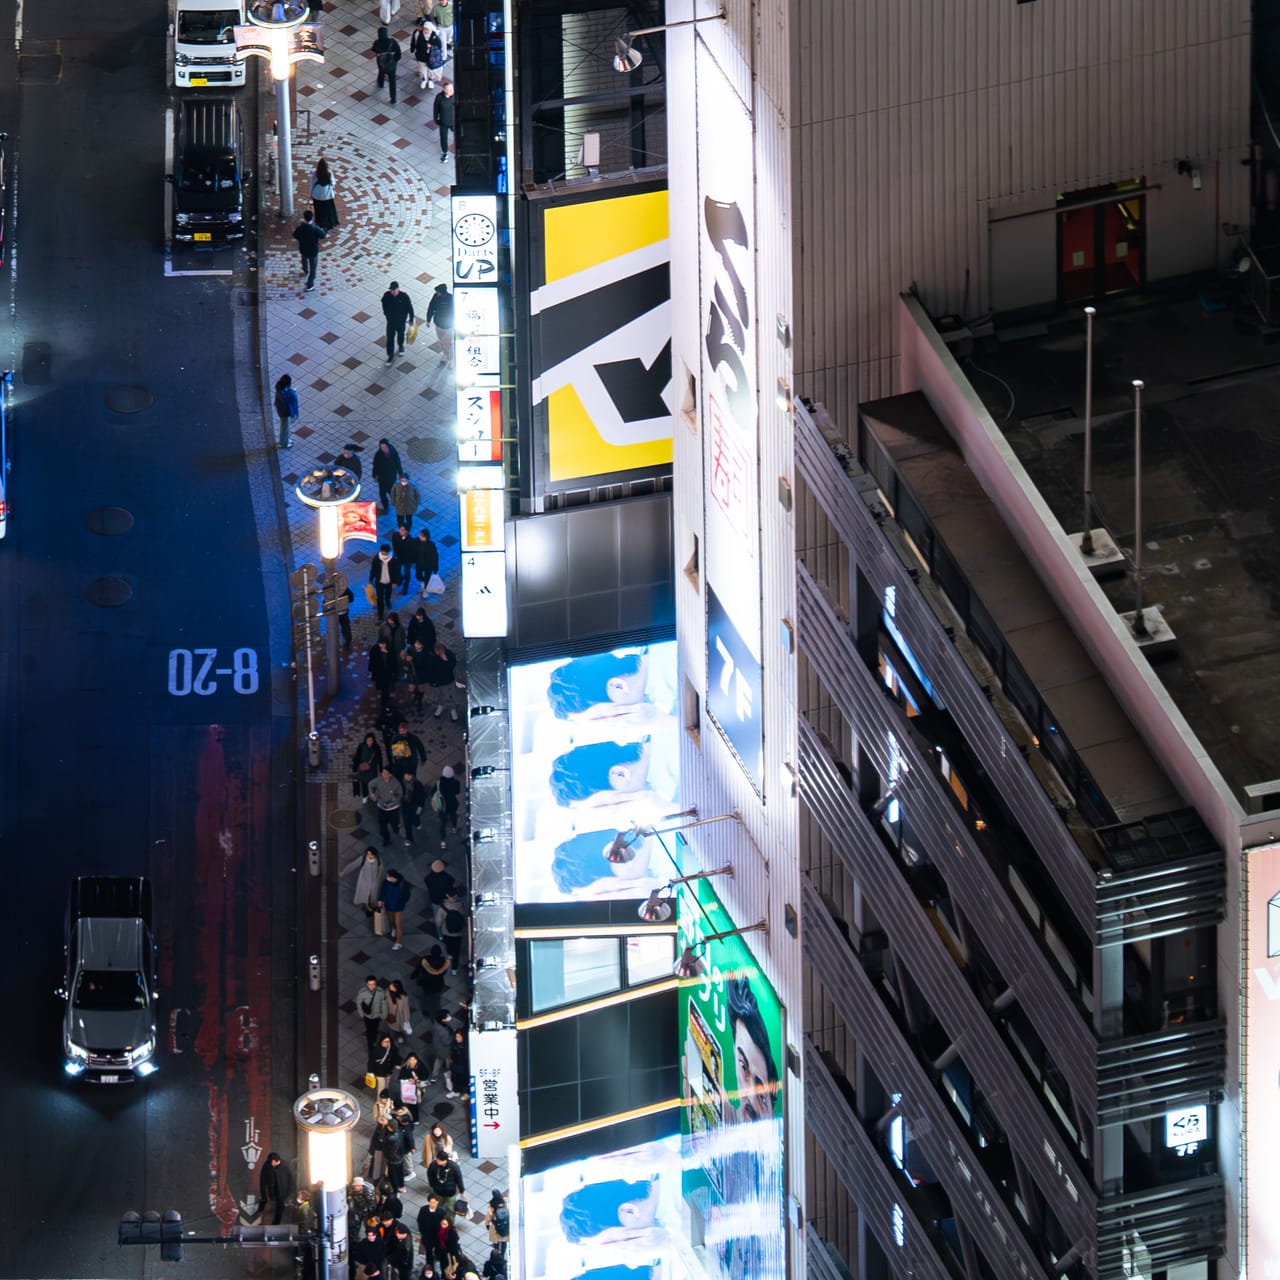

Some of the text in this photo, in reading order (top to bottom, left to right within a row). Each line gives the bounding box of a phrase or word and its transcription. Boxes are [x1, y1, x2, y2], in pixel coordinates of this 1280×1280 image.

[455, 258, 496, 280] UP
[167, 648, 260, 697] 8-20
[483, 1079, 499, 1120] 営業中
